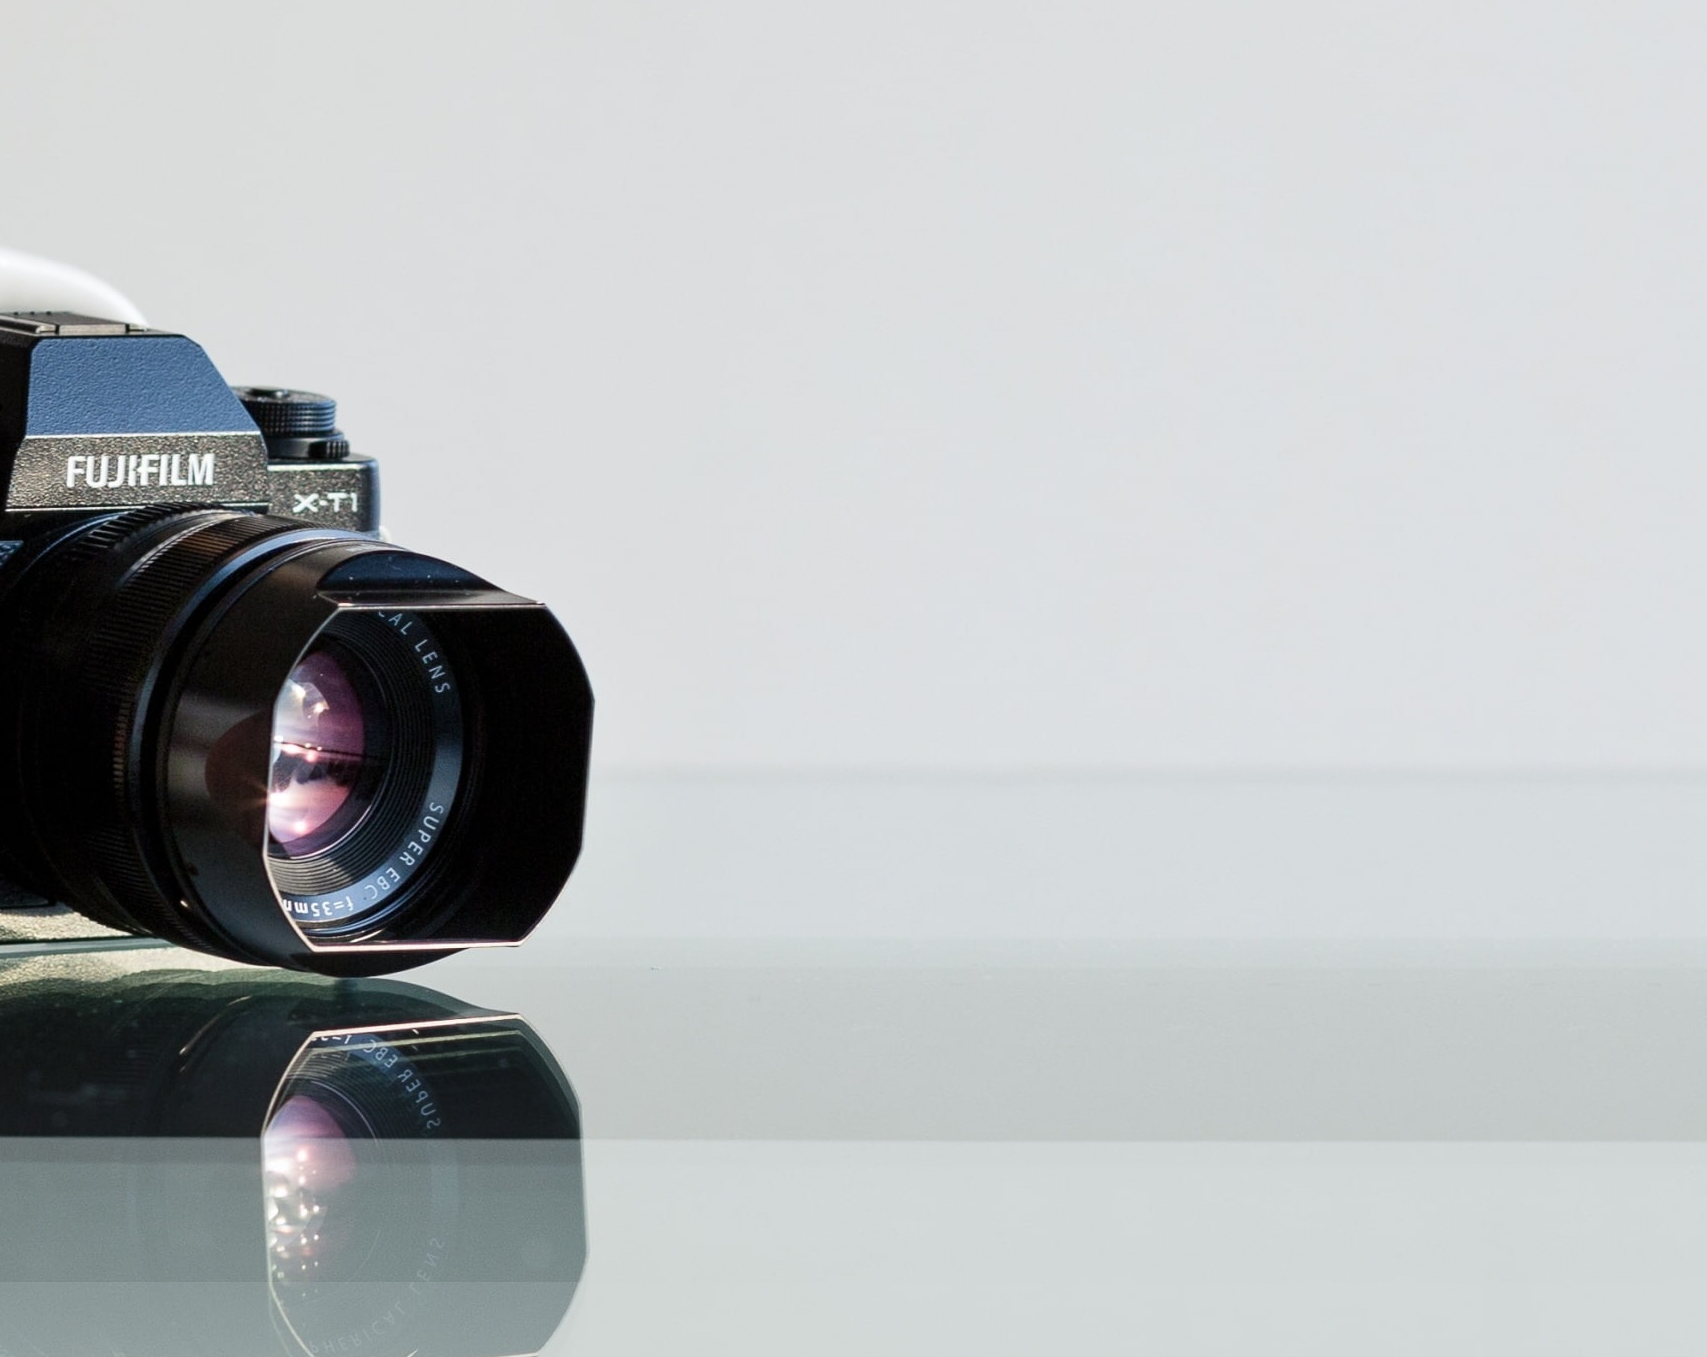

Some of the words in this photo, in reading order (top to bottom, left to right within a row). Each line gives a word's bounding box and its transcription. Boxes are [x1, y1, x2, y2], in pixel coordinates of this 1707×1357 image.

[65, 452, 216, 489] FUJIFILM
[291, 492, 359, 514] X-T1
[414, 638, 451, 694] LENS
[398, 800, 445, 867] SUPER
[363, 867, 402, 899] EBC
